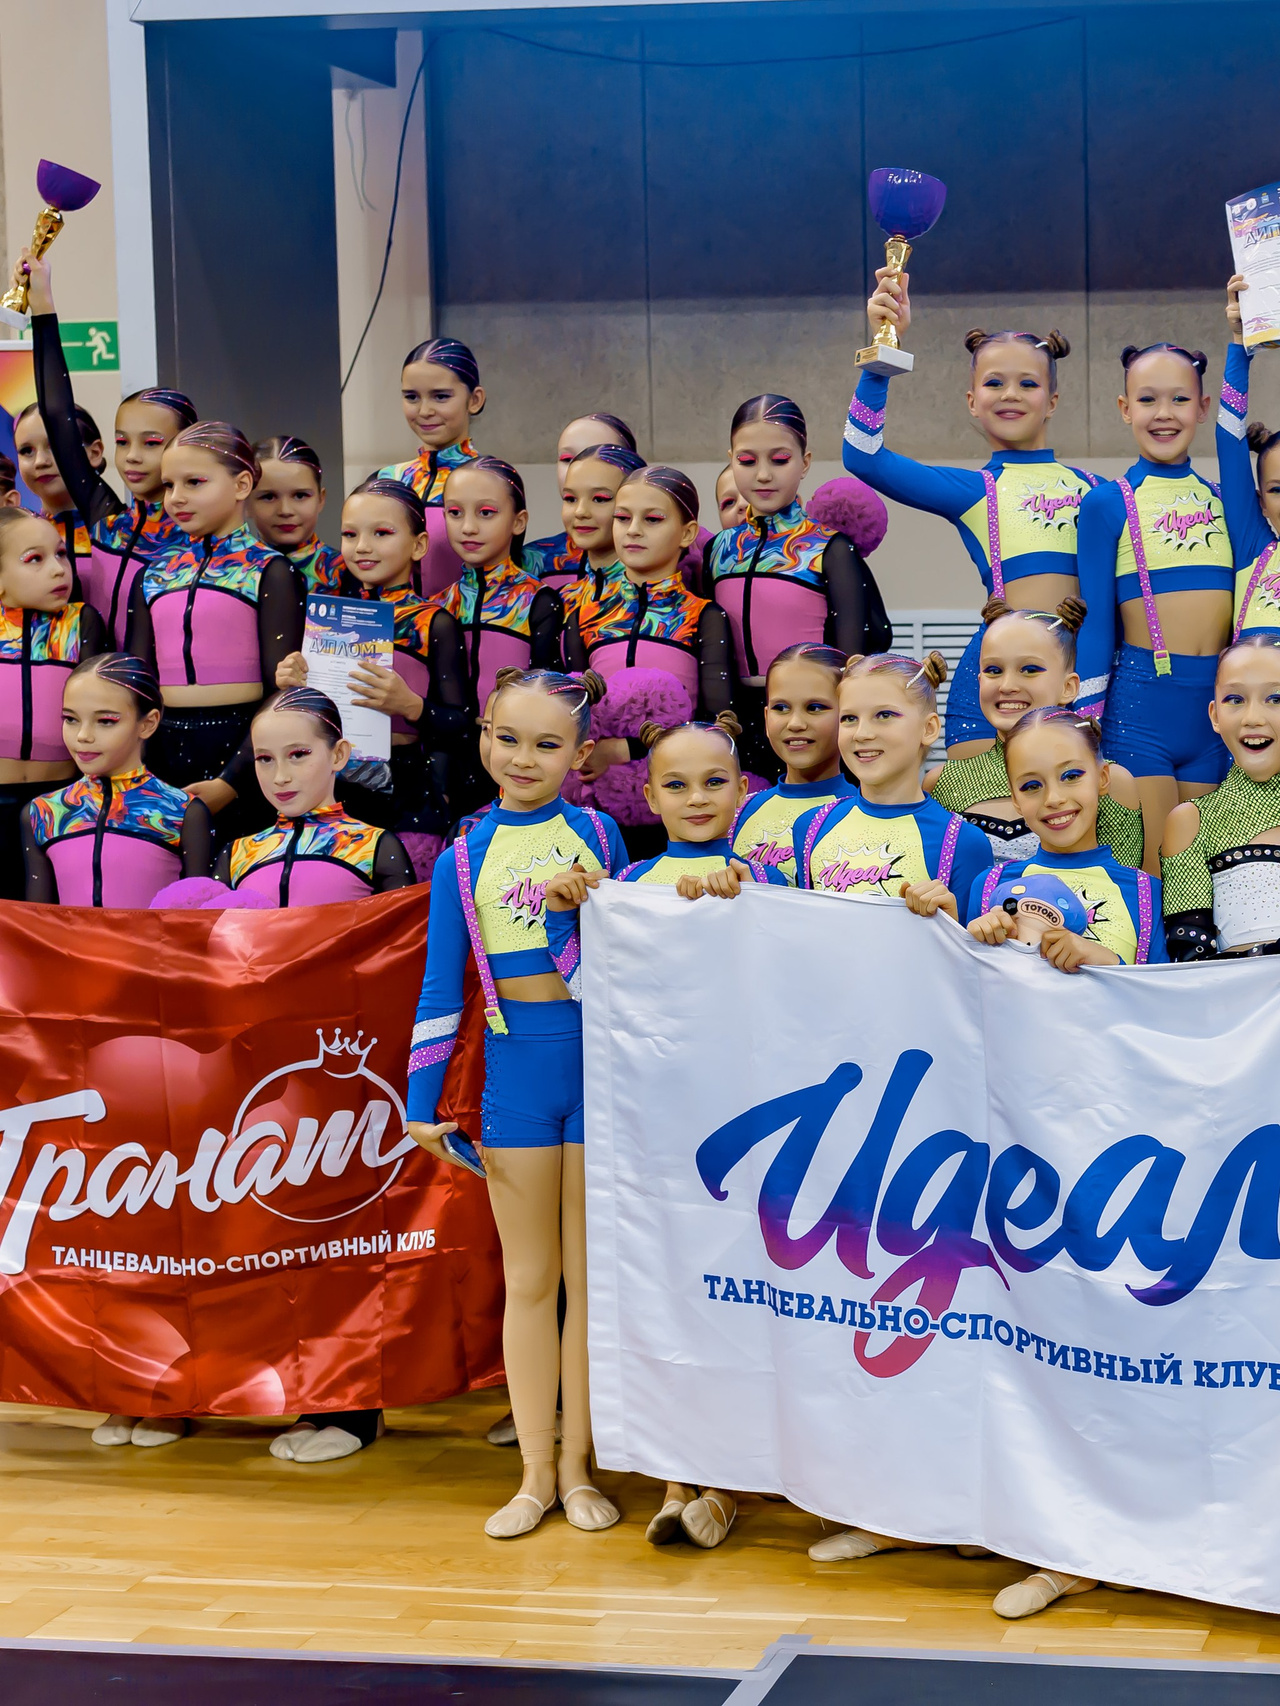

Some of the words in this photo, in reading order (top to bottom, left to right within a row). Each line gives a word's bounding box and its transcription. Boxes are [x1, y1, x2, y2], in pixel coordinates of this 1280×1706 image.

[1154, 508, 1214, 540] Идеал
[309, 637, 376, 660] ДИПЛОМ
[1024, 903, 1058, 923] TOTORO
[0, 1089, 418, 1275] Гранат
[52, 1228, 392, 1277] ТАНЦЕВАЛЬНО-СПОРТИВНЫЙ
[396, 1228, 436, 1253] КЛУБ
[703, 1273, 1183, 1387] ТАНЦЕВАЛЬНО-СПОРТИВНЫЙ
